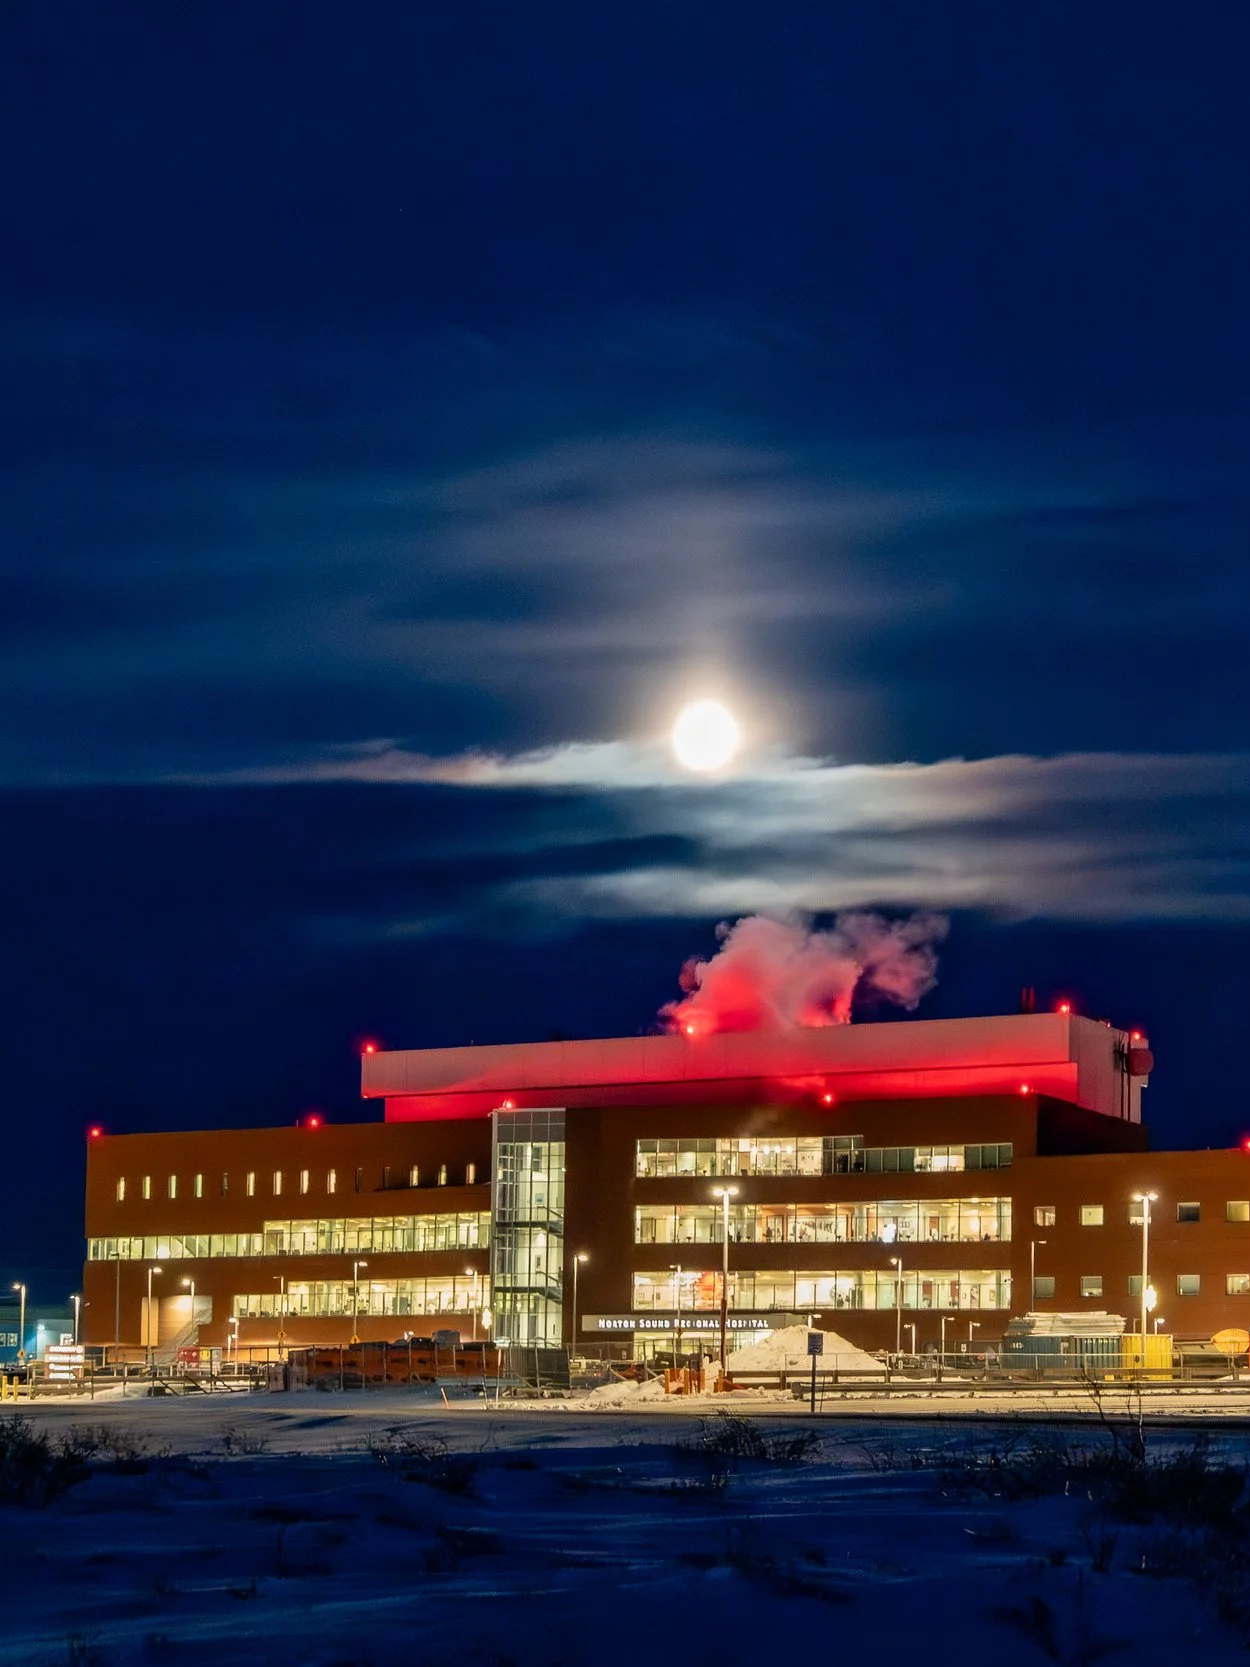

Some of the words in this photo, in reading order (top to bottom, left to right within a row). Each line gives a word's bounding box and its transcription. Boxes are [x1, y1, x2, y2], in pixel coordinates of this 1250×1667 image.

[598, 1318, 636, 1329] NORTON
[639, 1318, 670, 1329] SOUND
[674, 1317, 720, 1329] REGIONAL
